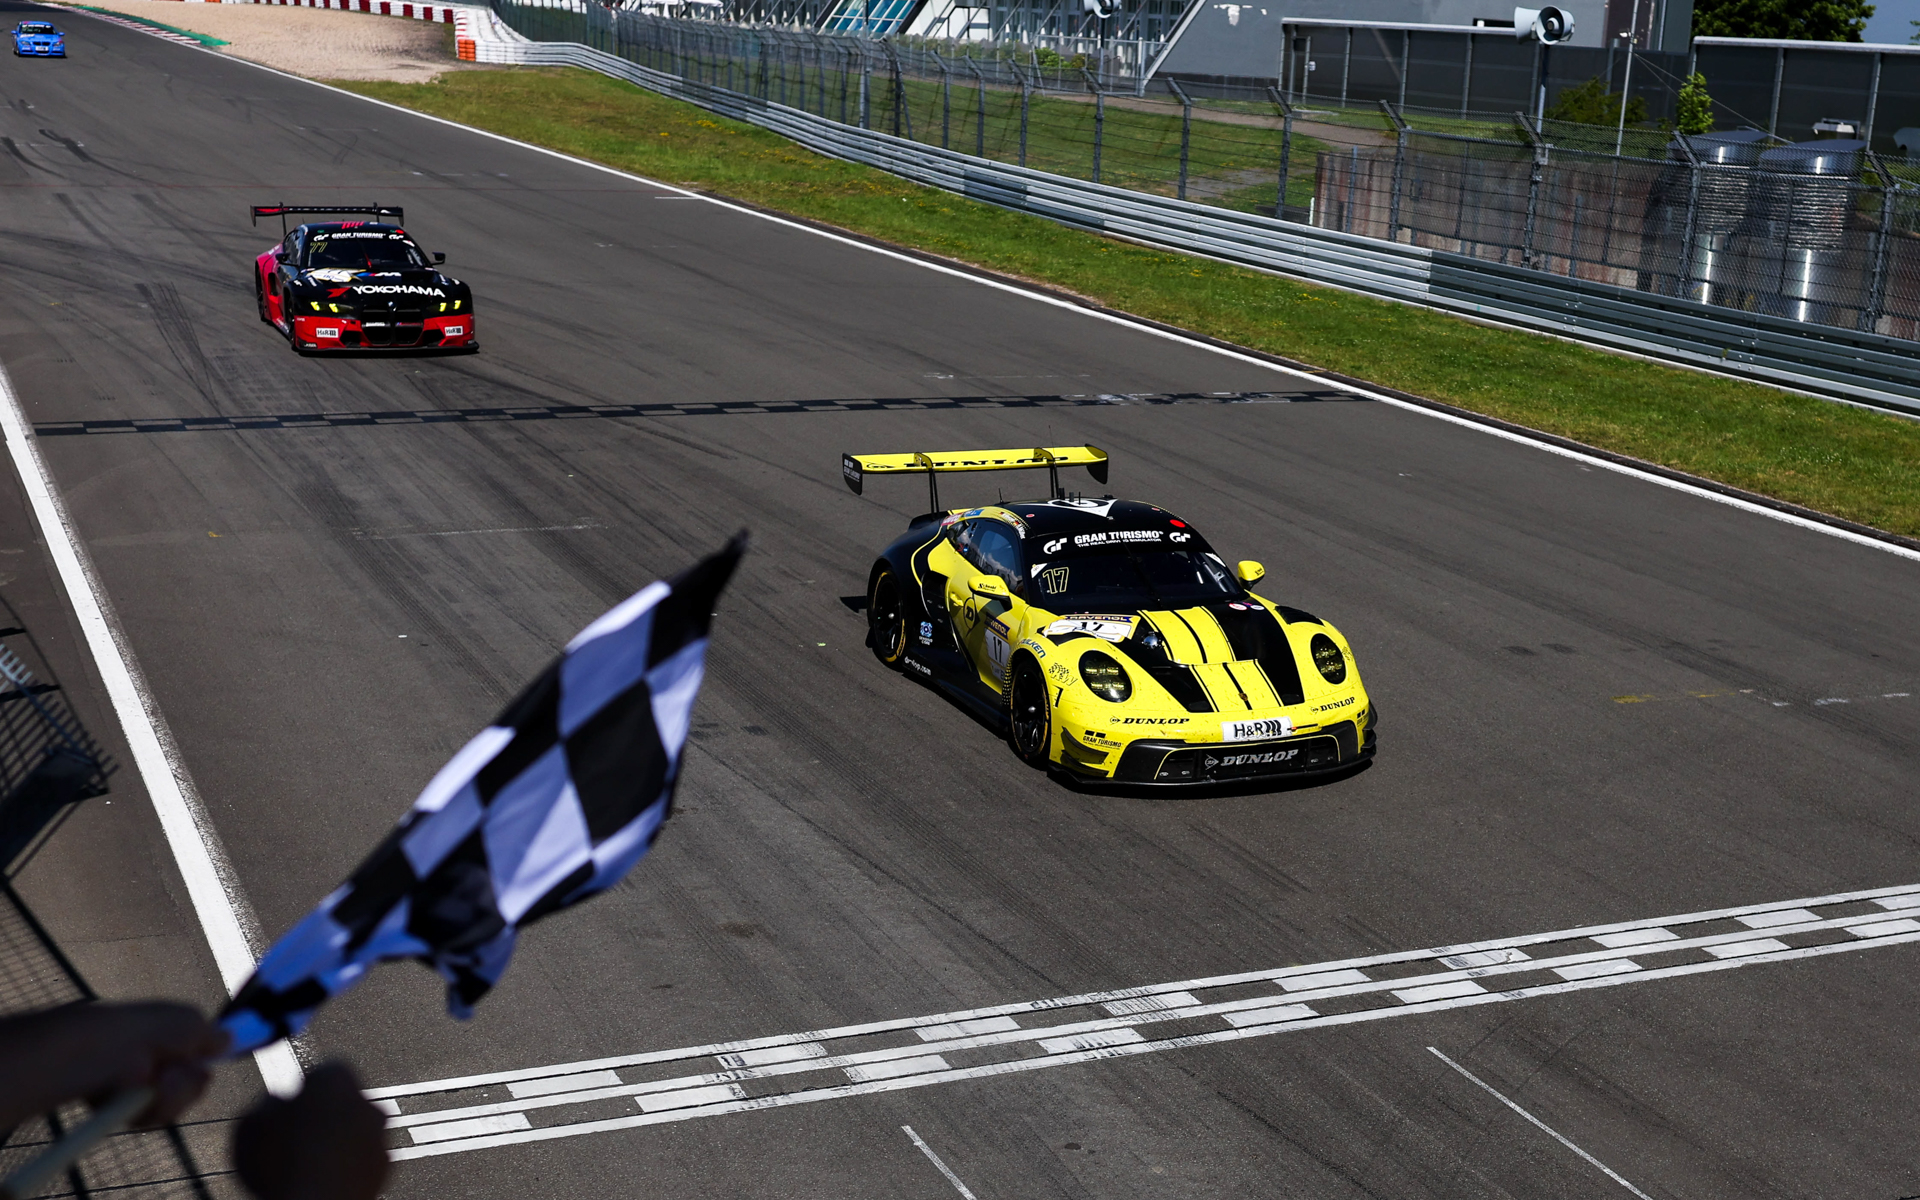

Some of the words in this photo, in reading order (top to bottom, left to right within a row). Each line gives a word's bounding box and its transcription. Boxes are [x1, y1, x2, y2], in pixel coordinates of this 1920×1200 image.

[310, 242, 328, 254] 77
[353, 285, 446, 298] YOKOHAMA
[1074, 532, 1107, 545] GRAN
[1108, 530, 1159, 541] TURISMO
[1042, 566, 1070, 595] 17
[1080, 621, 1105, 632] 17
[993, 636, 1003, 664] 17
[1320, 697, 1356, 712] DUNLOP
[1122, 717, 1191, 725] DUNLOP
[1233, 721, 1264, 738] H&R
[1220, 748, 1299, 767] DUNLOP
